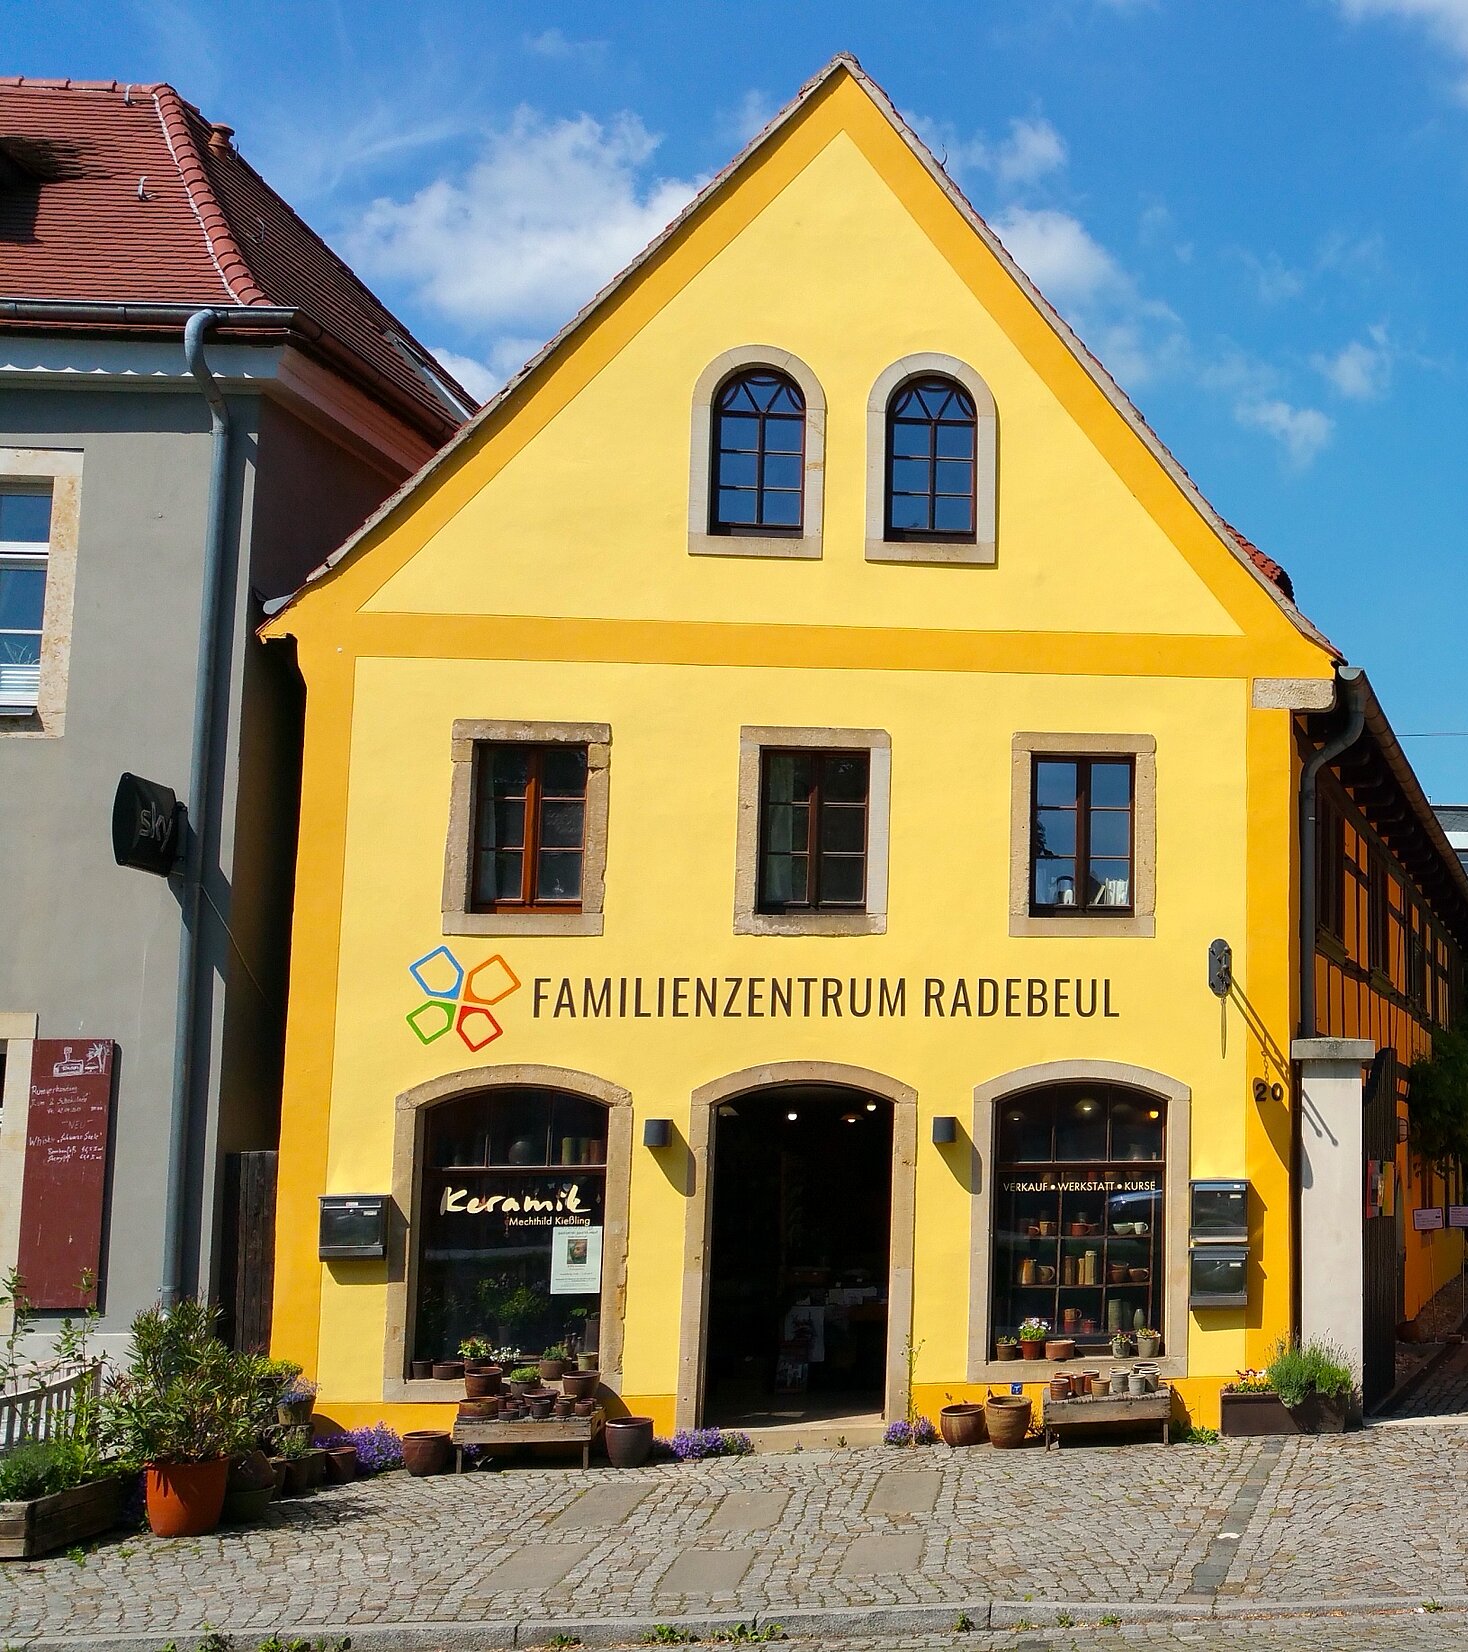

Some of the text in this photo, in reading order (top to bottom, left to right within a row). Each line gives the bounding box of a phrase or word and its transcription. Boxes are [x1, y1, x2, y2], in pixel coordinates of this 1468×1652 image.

[139, 801, 173, 853] sky
[532, 977, 1122, 1019] FAMILIENZENTRUM RADEBEUL
[1255, 1082, 1285, 1102] 20
[1003, 1181, 1156, 1192] VERKAUF WERKSTATT KURSE
[439, 1184, 592, 1216] Keramik
[509, 1216, 591, 1227] Mechthild Kießling
